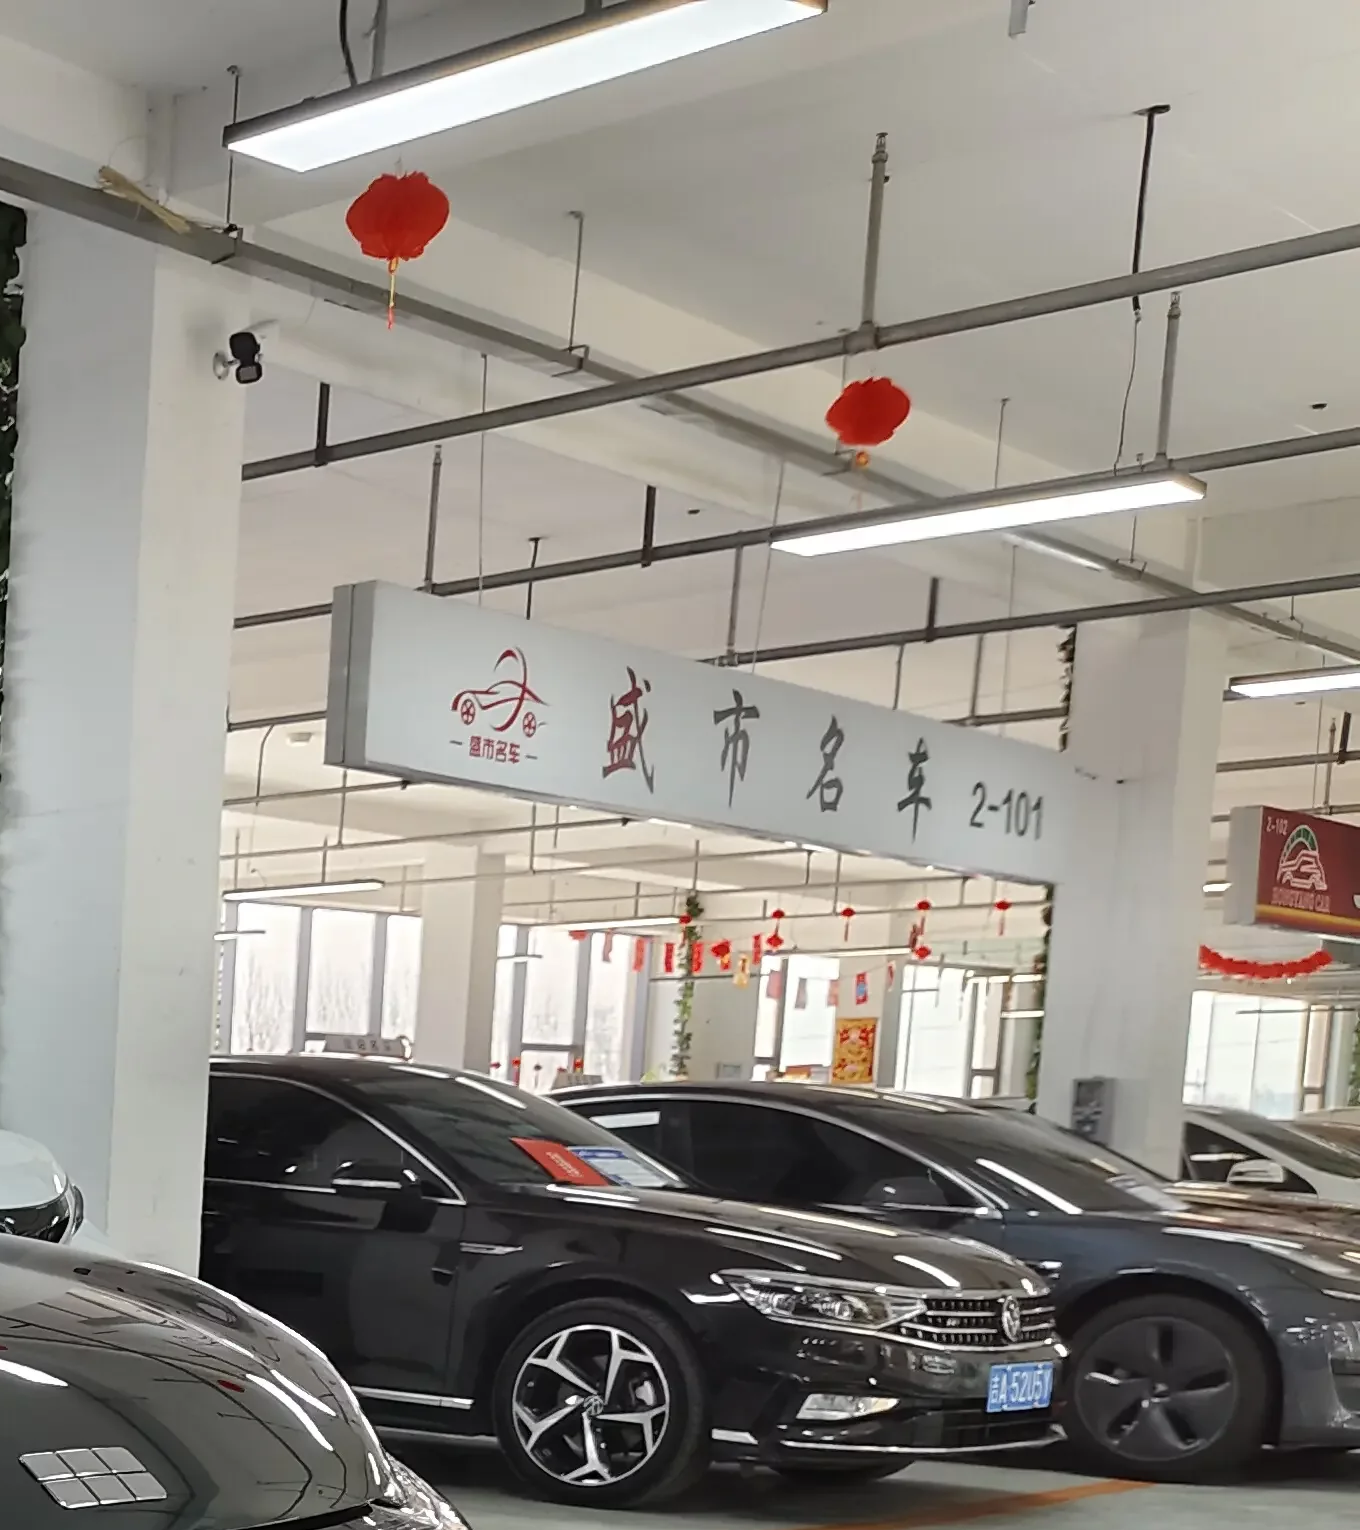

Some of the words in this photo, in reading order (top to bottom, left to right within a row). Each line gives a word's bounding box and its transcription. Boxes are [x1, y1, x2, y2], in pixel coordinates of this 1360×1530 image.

[602, 666, 932, 843] 盛市名车
[970, 781, 1044, 840] 2-101
[1266, 816, 1289, 836] 2-102
